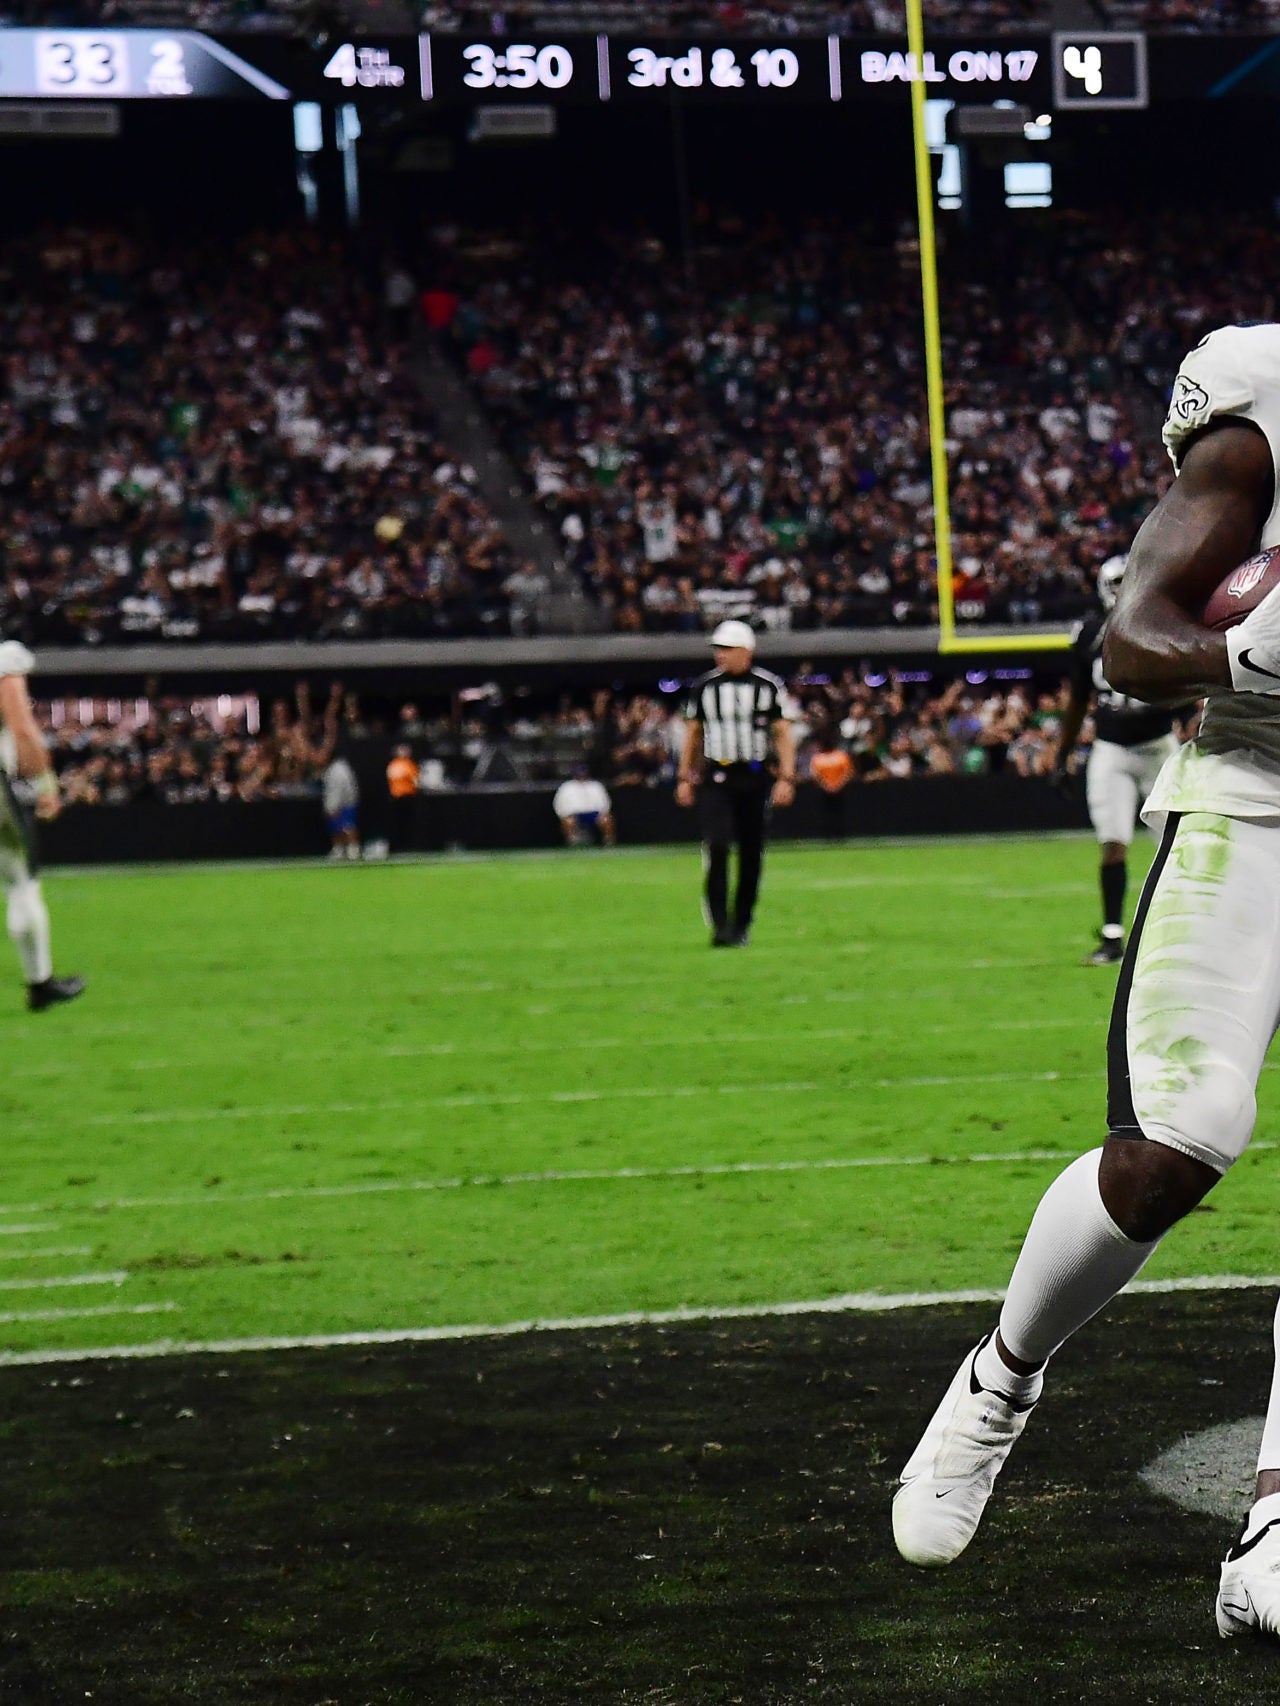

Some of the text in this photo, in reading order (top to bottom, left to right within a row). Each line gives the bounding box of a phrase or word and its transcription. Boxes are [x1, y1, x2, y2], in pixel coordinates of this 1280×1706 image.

[50, 42, 115, 85] 33
[150, 39, 184, 81] 2
[462, 43, 574, 88] 3:50
[627, 47, 799, 88] 3rd & 10
[860, 50, 1039, 83] BALL ON 17
[1063, 46, 1102, 94] 4
[1232, 564, 1261, 589] NFL
